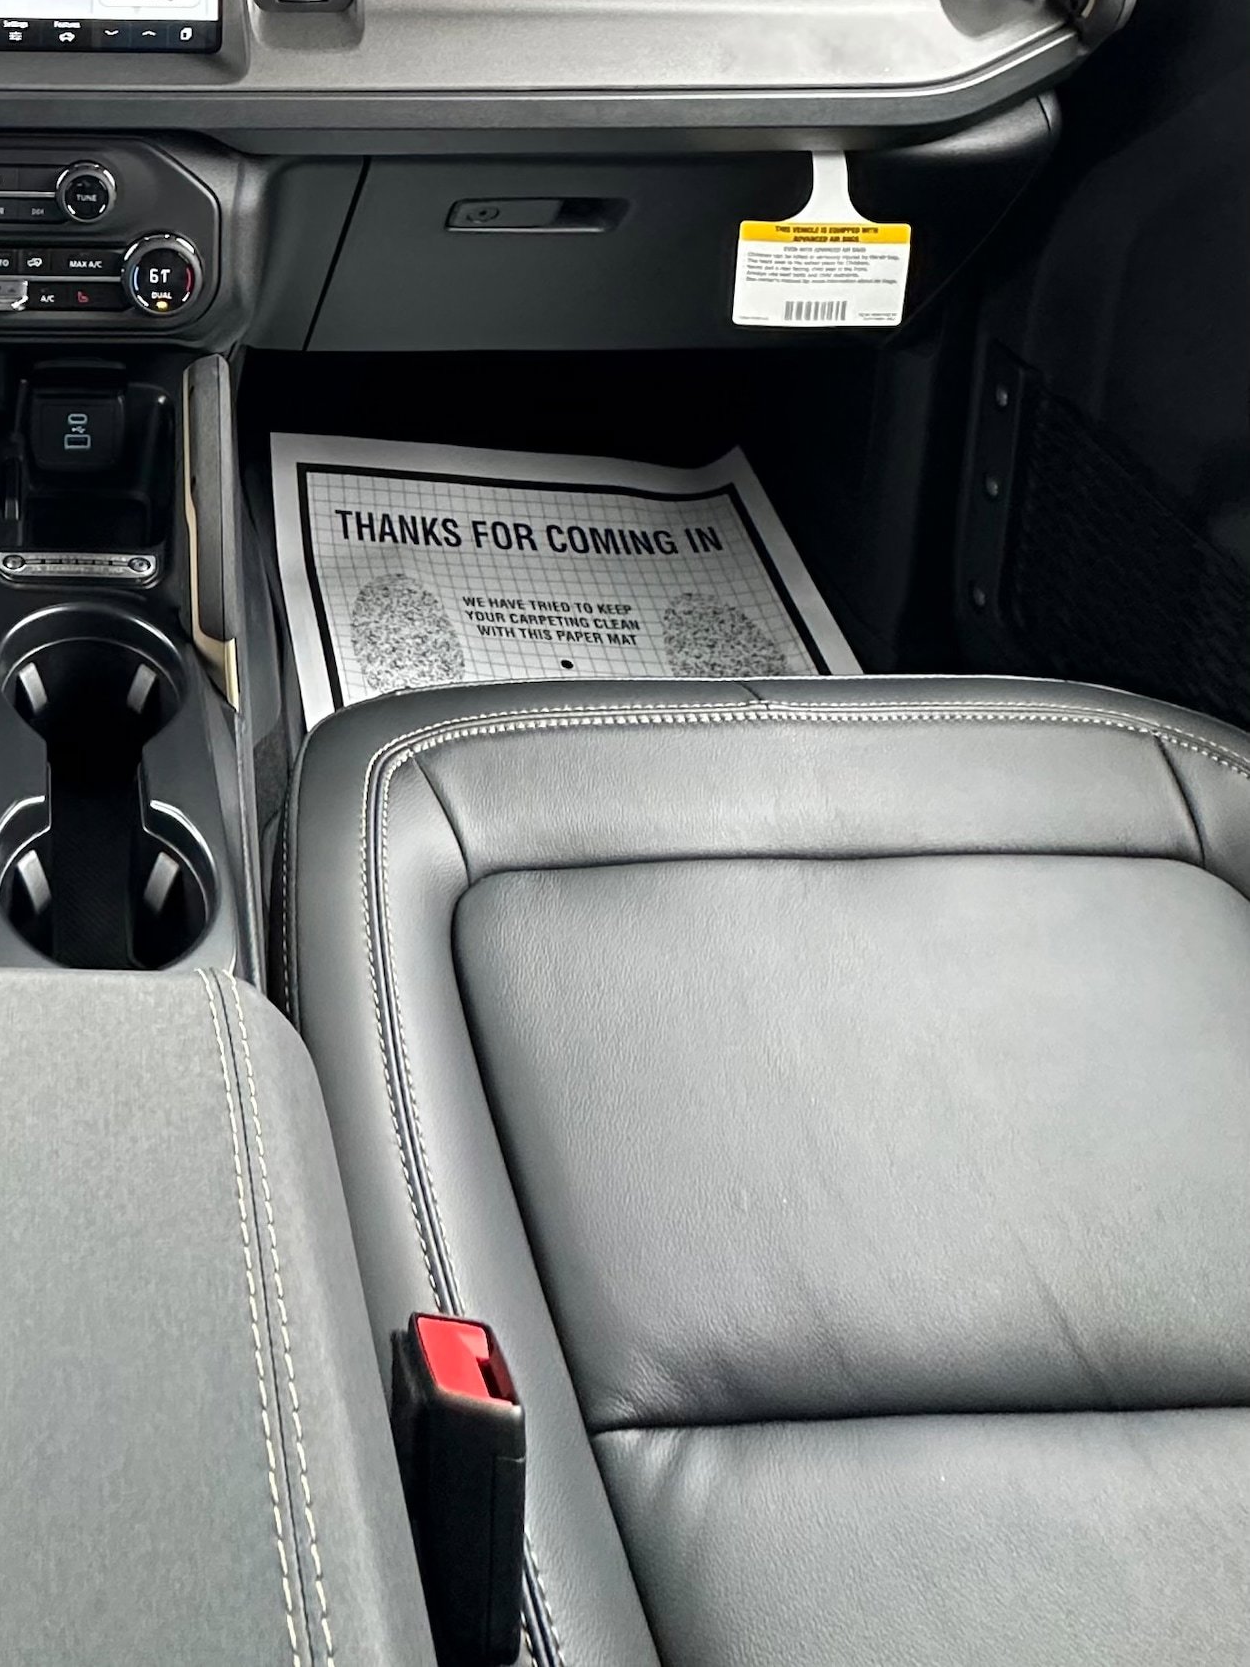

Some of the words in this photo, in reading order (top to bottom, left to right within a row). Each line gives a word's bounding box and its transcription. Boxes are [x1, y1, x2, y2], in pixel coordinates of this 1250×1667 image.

[76, 193, 98, 202] TUNE
[69, 260, 87, 269] MAX
[88, 260, 103, 269] A/C
[40, 294, 55, 303] A/C
[151, 291, 172, 300] DUAL
[335, 509, 462, 548] THANKS
[471, 520, 538, 551] FOR
[547, 524, 678, 556] COMING
[686, 526, 724, 552] IN
[462, 596, 486, 609] WE
[488, 597, 525, 611] HAVE
[529, 599, 571, 613] TRIED
[575, 602, 593, 614] TO
[597, 603, 632, 616] KEEP
[464, 610, 506, 624] YOUR
[509, 612, 591, 628] CARPETING
[593, 616, 640, 631] CLEAN
[476, 624, 517, 638] WITH
[520, 627, 553, 641] THIS
[556, 629, 604, 644] PAPER
[607, 633, 638, 646] MAT
